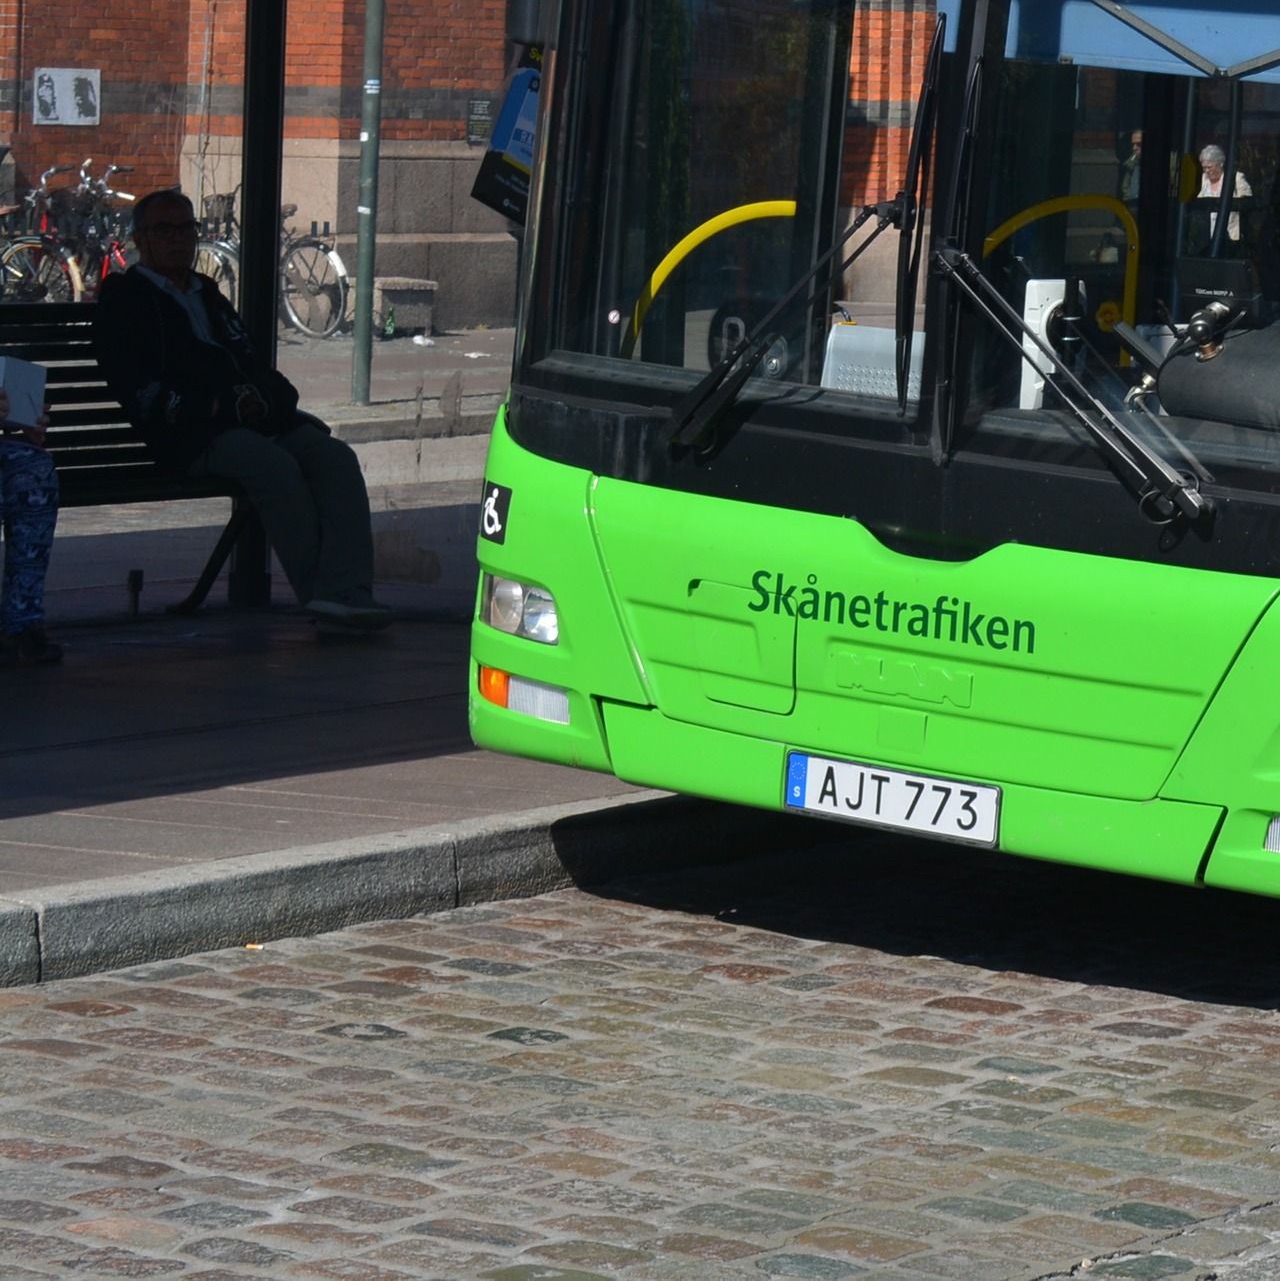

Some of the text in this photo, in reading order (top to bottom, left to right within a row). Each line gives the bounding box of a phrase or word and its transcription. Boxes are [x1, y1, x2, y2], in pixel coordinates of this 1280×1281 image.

[747, 569, 1036, 655] Skånetrafiken
[792, 785, 801, 798] S
[817, 765, 979, 831] AJT 773
